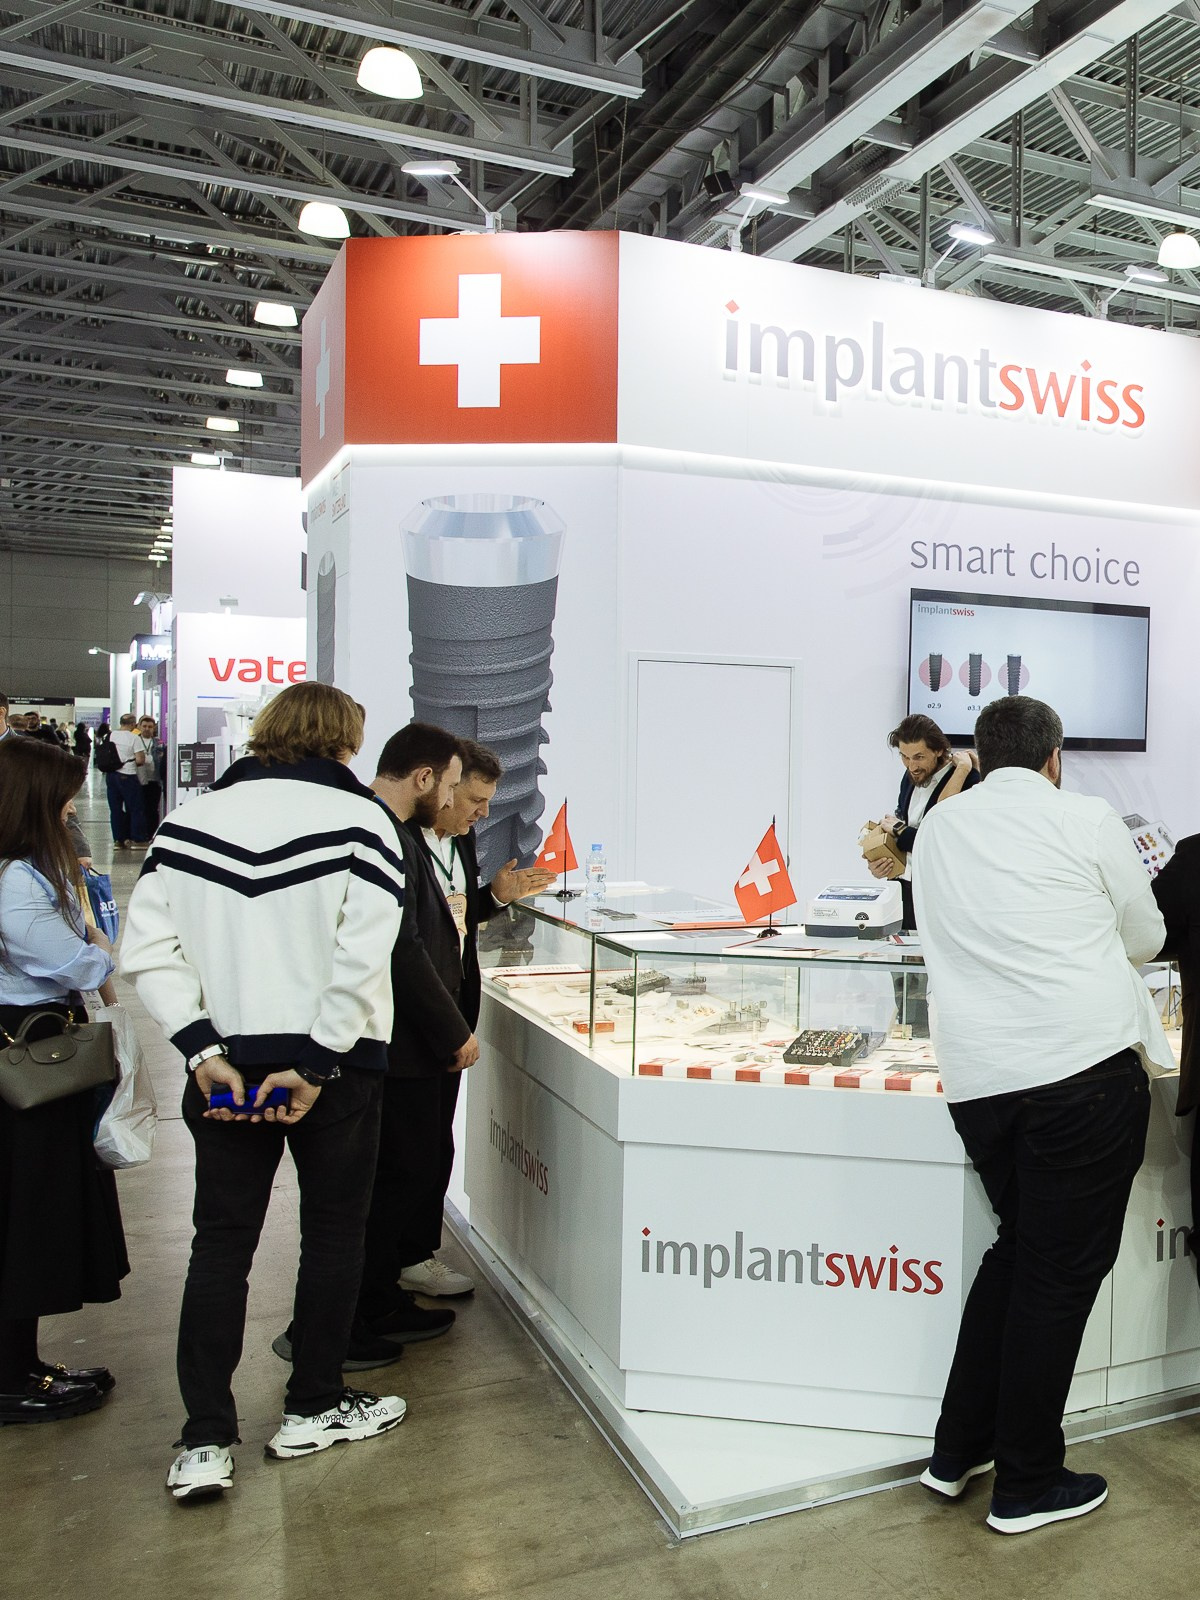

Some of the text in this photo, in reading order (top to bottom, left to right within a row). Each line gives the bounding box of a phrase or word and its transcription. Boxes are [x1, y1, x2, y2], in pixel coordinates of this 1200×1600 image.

[725, 299, 1146, 430] implantswiss
[910, 540, 1141, 587] smart choice
[917, 604, 975, 617] implantswiss
[489, 1108, 549, 1196] implantswiss
[641, 1227, 944, 1295] implantswiss
